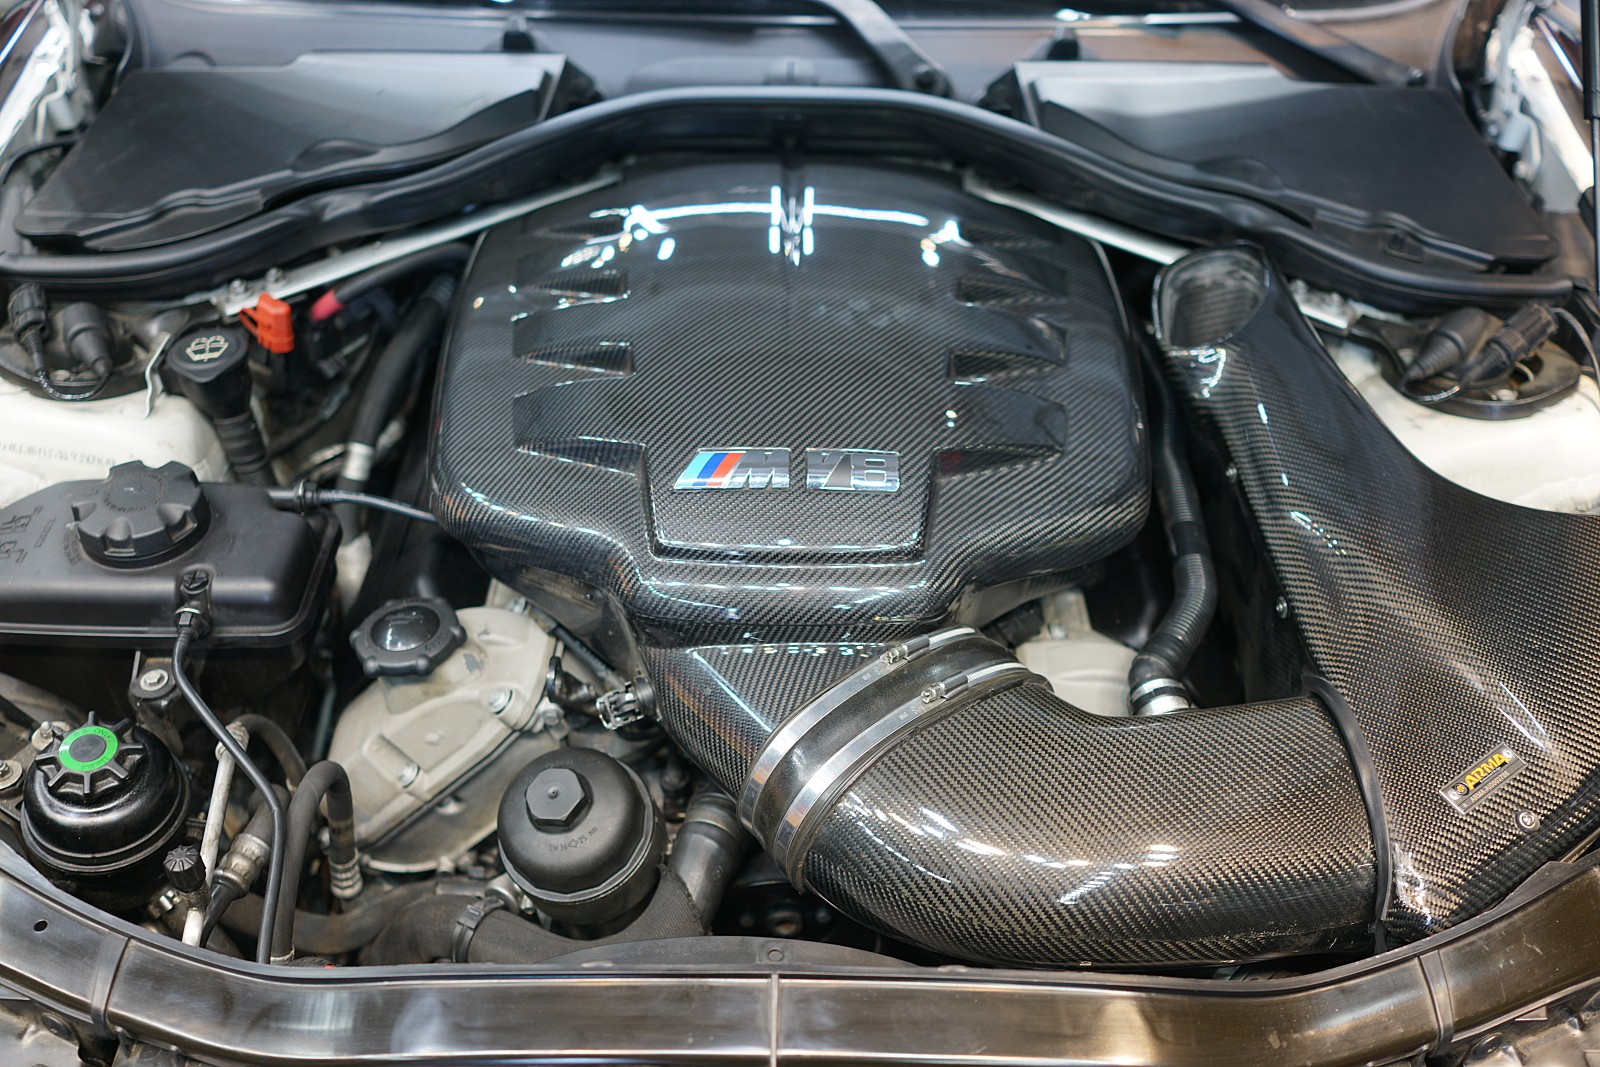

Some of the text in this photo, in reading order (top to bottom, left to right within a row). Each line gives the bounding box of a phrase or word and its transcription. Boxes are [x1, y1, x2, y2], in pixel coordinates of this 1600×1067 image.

[806, 448, 900, 491] V8
[1465, 753, 1511, 790] ARMA
[578, 834, 588, 844] 25
